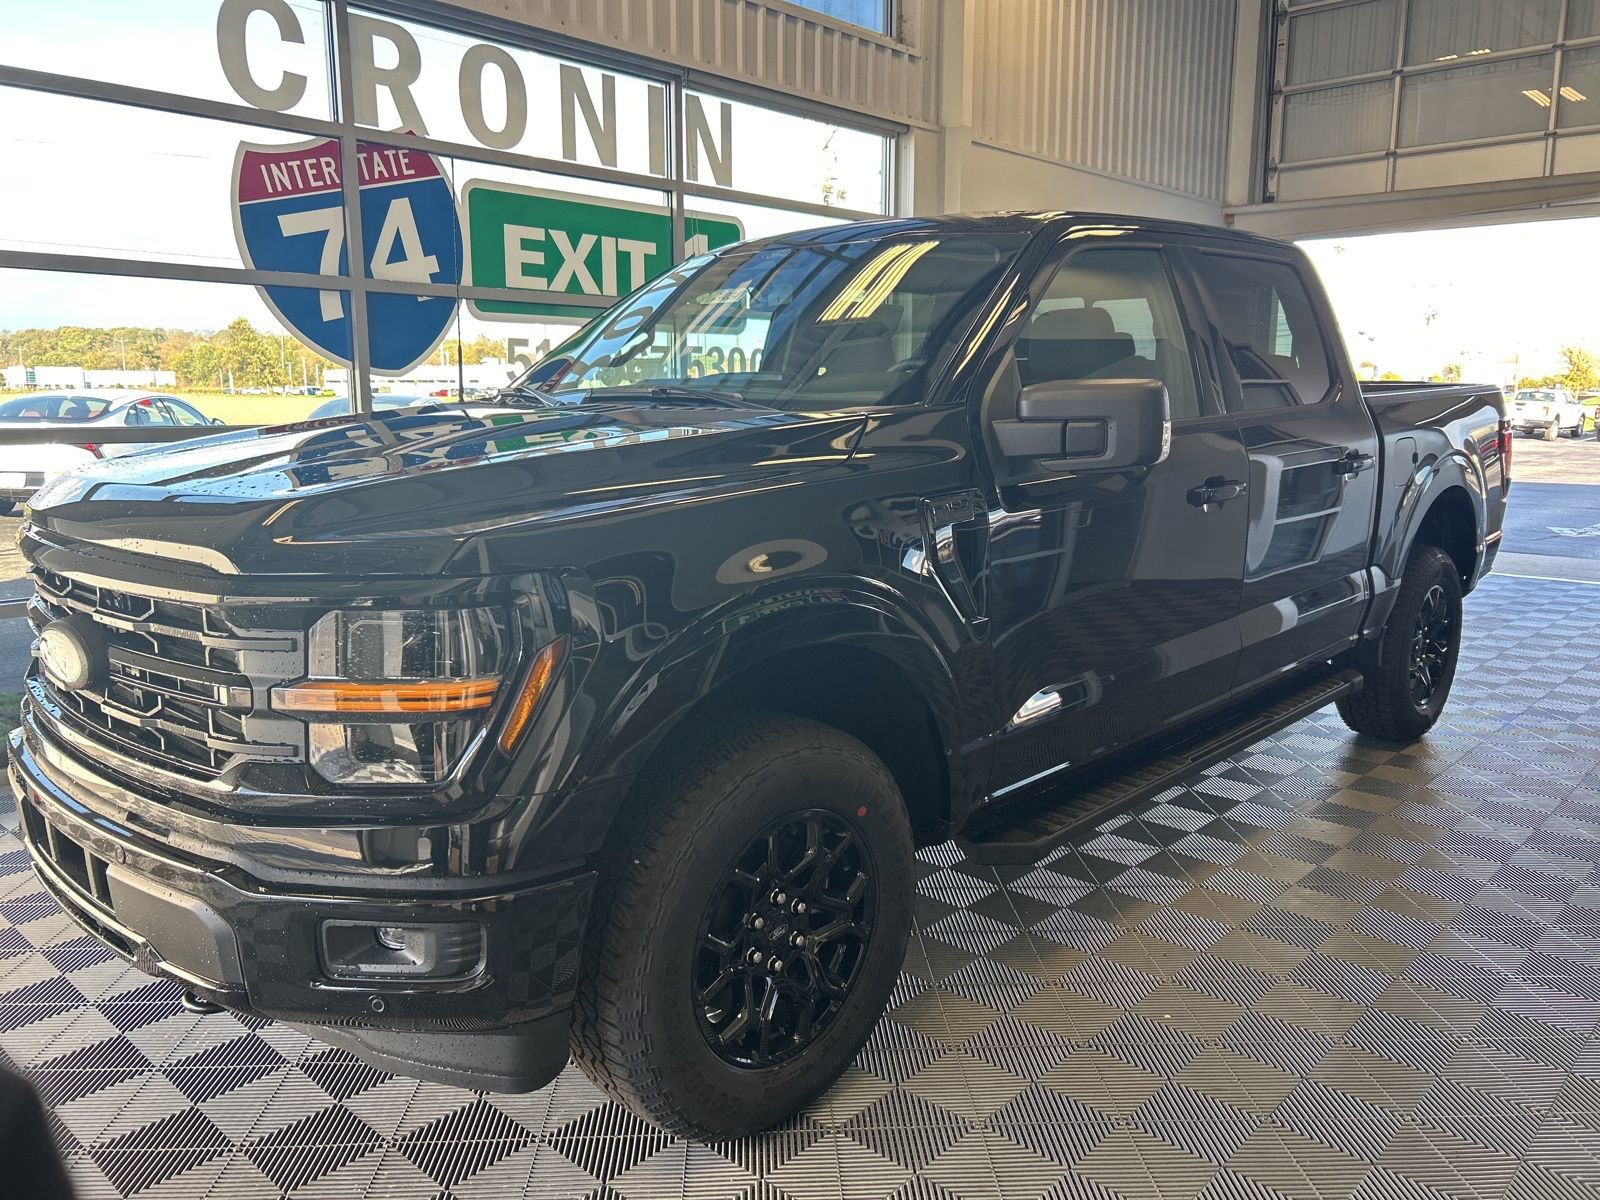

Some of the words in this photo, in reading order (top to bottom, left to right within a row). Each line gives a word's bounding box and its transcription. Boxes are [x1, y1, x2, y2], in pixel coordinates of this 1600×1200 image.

[216, 0, 733, 187] CRONIN
[260, 149, 416, 193] INTERTATE
[277, 197, 440, 322] 74
[503, 223, 657, 297] EXIT
